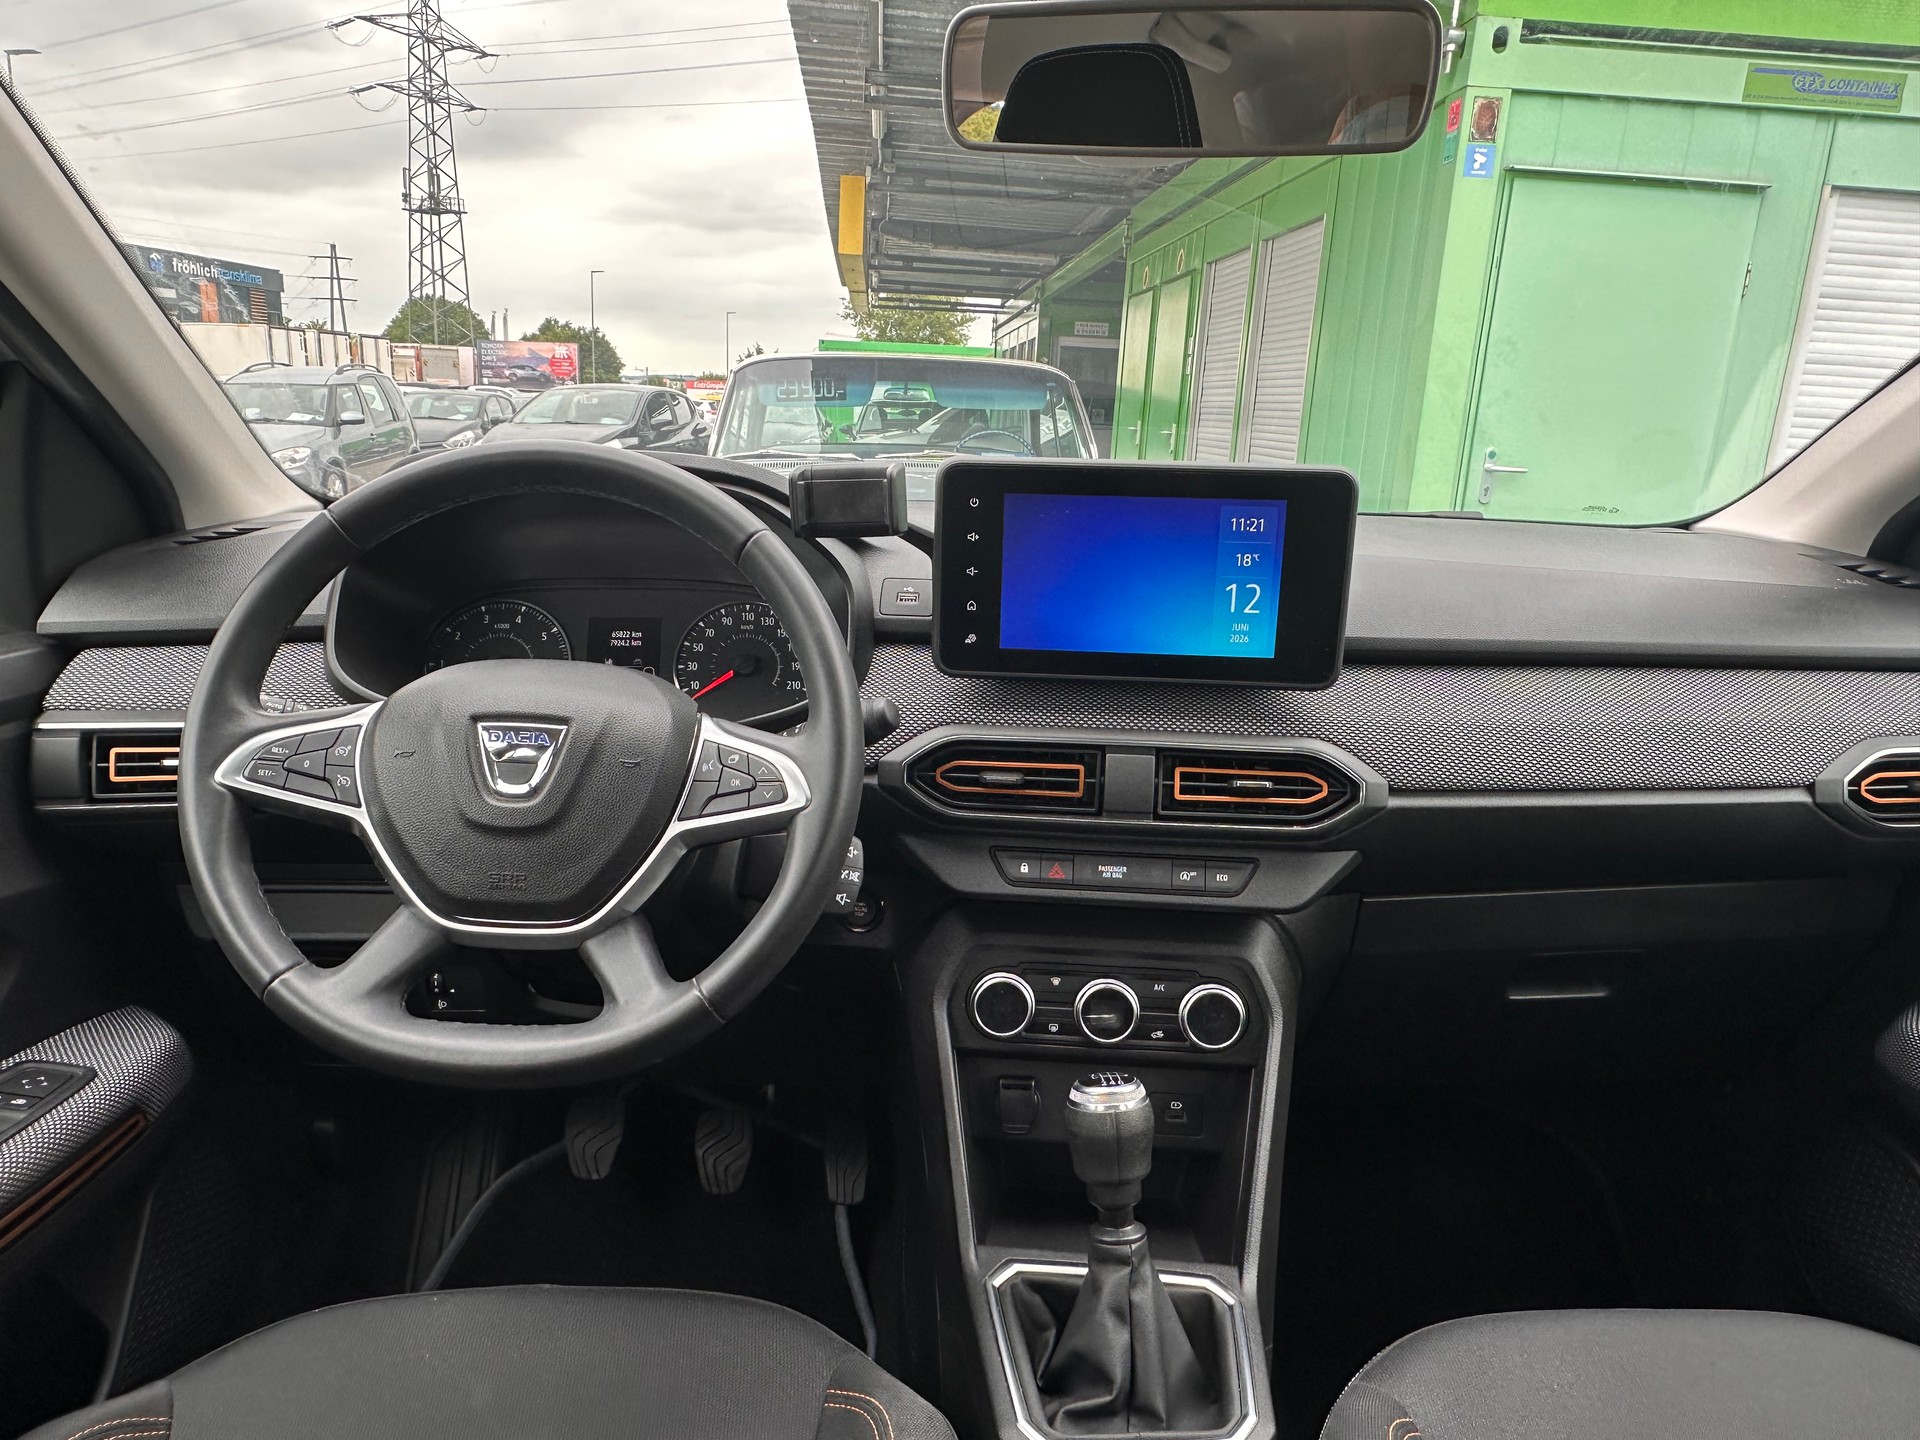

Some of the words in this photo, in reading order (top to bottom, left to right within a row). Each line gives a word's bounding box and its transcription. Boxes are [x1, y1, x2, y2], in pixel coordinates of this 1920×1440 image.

[1828, 79, 1900, 93] CONTAINEX
[1231, 518, 1264, 532] 11:21
[1225, 583, 1261, 614] 12
[483, 615, 489, 624] 3
[516, 615, 522, 624] 4
[741, 612, 754, 621] 110
[721, 617, 733, 626] 90
[760, 617, 775, 626] 130
[1231, 623, 1249, 632] JUNI
[455, 632, 461, 640] 2
[541, 632, 547, 641] 5
[705, 629, 715, 637] 70
[777, 629, 786, 638] 15
[1230, 635, 1249, 643] 2026
[693, 643, 704, 652] 50
[687, 662, 698, 671] 30
[791, 662, 800, 671] 19
[690, 681, 700, 690] 10
[787, 681, 800, 690] 210
[488, 730, 551, 746] DACIA
[730, 779, 741, 787] OK
[1098, 865, 1128, 873] PASSENGER
[1216, 874, 1228, 882] ECO
[1154, 984, 1165, 992] A/C
